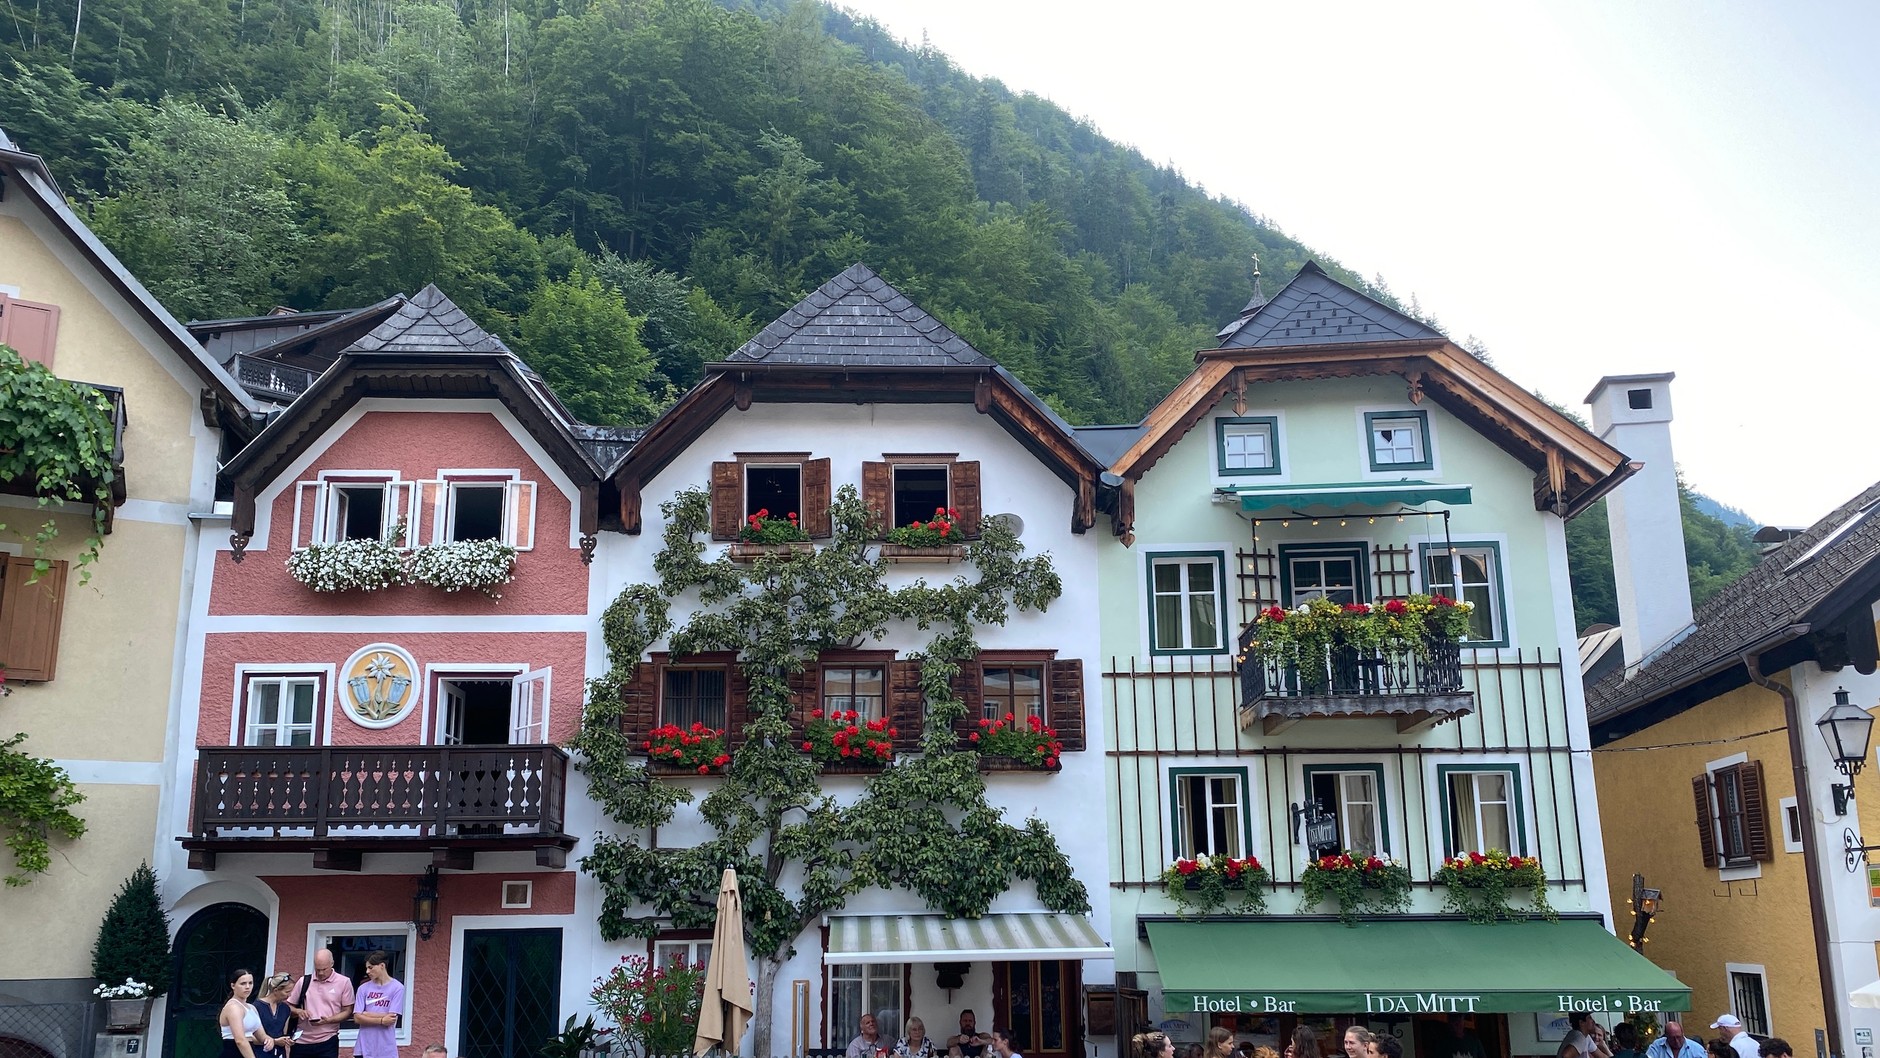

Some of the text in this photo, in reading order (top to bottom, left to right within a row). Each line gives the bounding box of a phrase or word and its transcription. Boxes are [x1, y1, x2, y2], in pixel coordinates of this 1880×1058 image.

[367, 991, 383, 999] JUST
[1193, 995, 1296, 1012] Hotel Bar
[1364, 993, 1480, 1013] IDA MITT
[1558, 995, 1661, 1012] Hotel Bar
